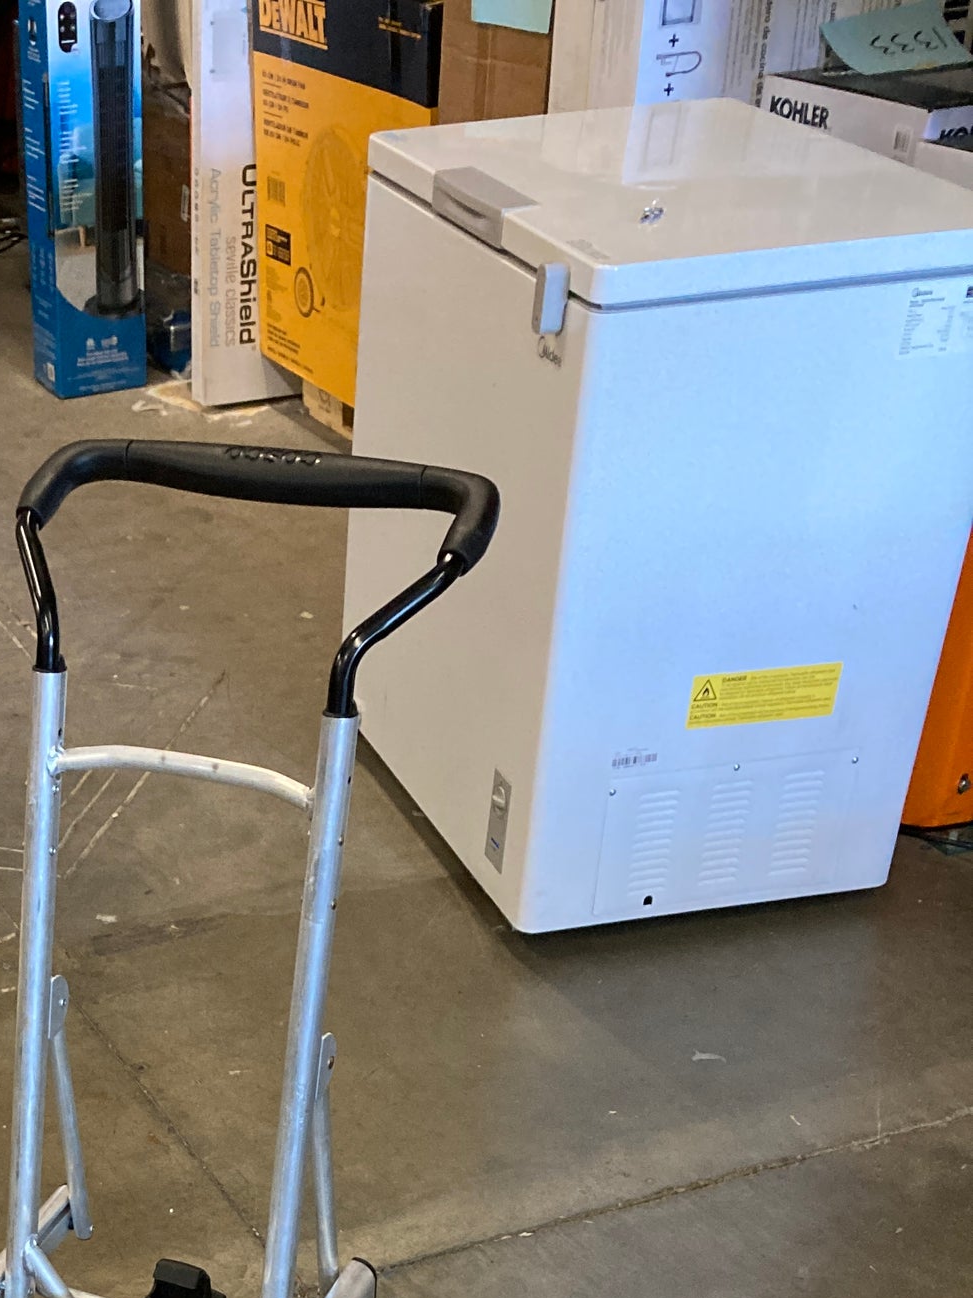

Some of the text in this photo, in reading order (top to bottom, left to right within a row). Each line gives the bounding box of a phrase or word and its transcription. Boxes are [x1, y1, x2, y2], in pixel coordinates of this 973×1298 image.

[769, 95, 830, 130] KOHLER
[207, 168, 222, 347] Acrylic Tabletop Shield
[225, 237, 237, 347] seville classics
[225, 446, 323, 466] COSCO
